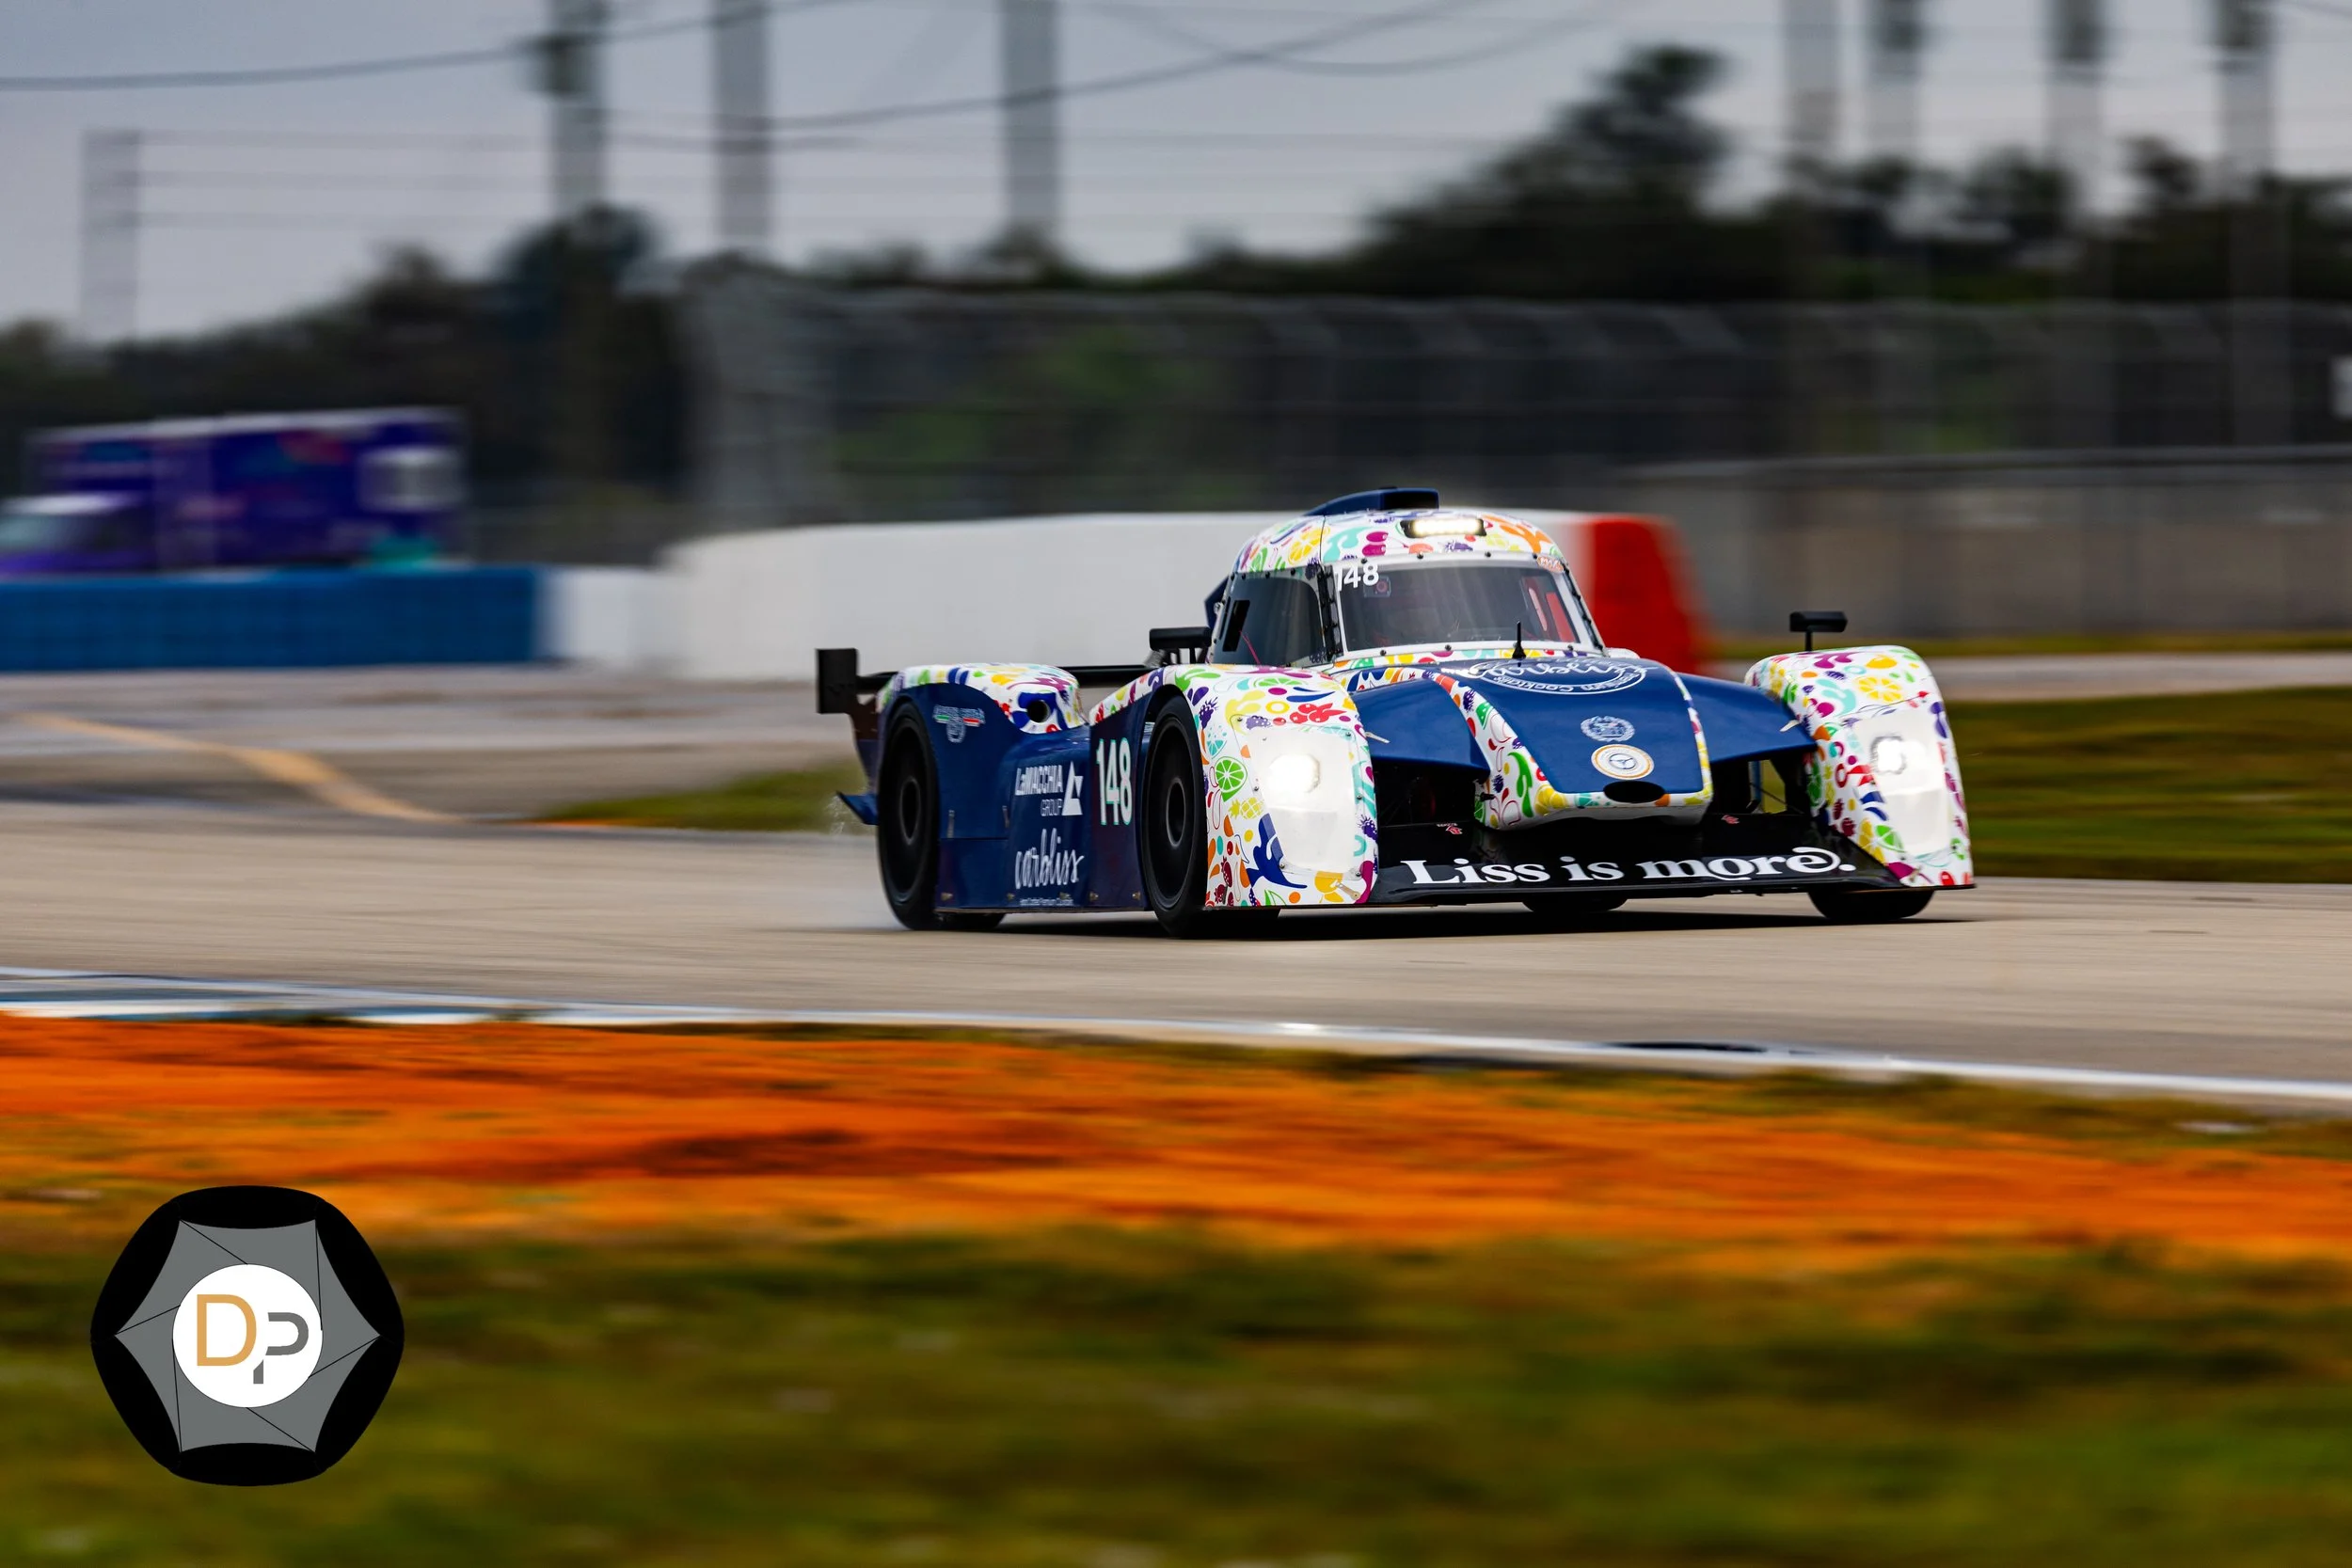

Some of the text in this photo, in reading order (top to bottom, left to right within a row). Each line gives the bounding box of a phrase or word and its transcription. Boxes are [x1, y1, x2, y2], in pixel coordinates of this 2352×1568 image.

[1334, 562, 1379, 592] 148
[1096, 736, 1133, 826] 148
[1041, 798, 1063, 816] GROUP
[1400, 847, 1856, 885] Liss is more.
